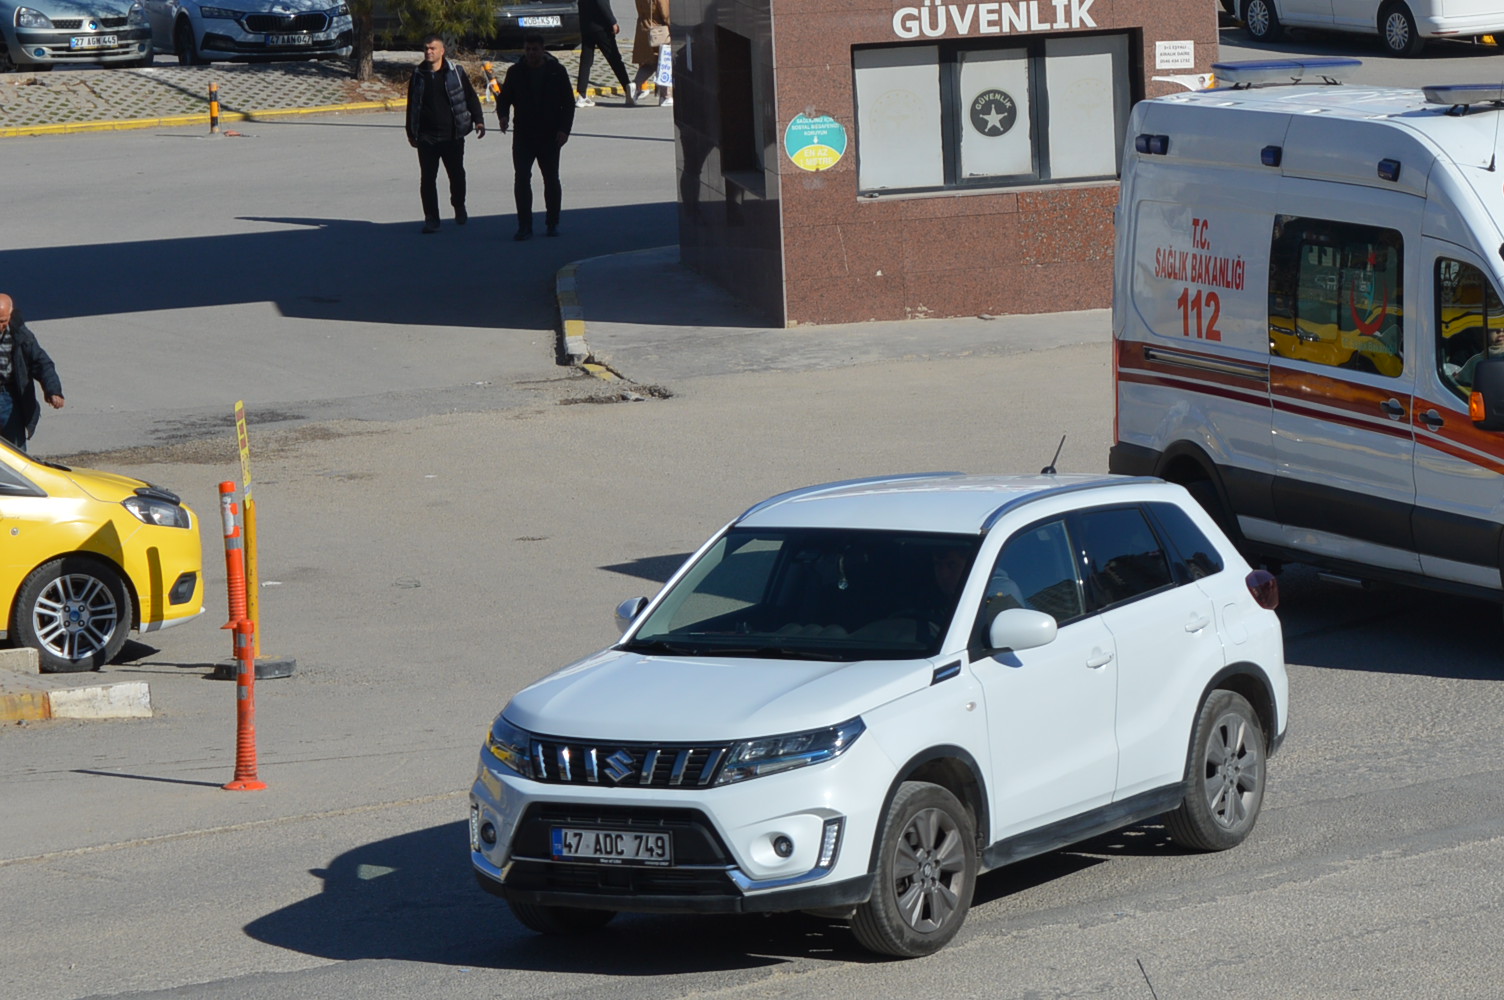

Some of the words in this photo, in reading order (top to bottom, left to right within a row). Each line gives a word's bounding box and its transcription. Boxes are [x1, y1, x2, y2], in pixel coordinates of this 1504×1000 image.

[102, 36, 116, 45] 445
[975, 92, 1012, 110] GÜVENLİK
[1192, 218, 1210, 250] T.C.
[1154, 244, 1188, 282] SAĞLIK
[1190, 253, 1245, 291] BAKANLIĞI
[1177, 287, 1222, 342] 112
[564, 832, 583, 854] 47
[594, 833, 625, 856] ADC
[634, 835, 666, 858] 749
